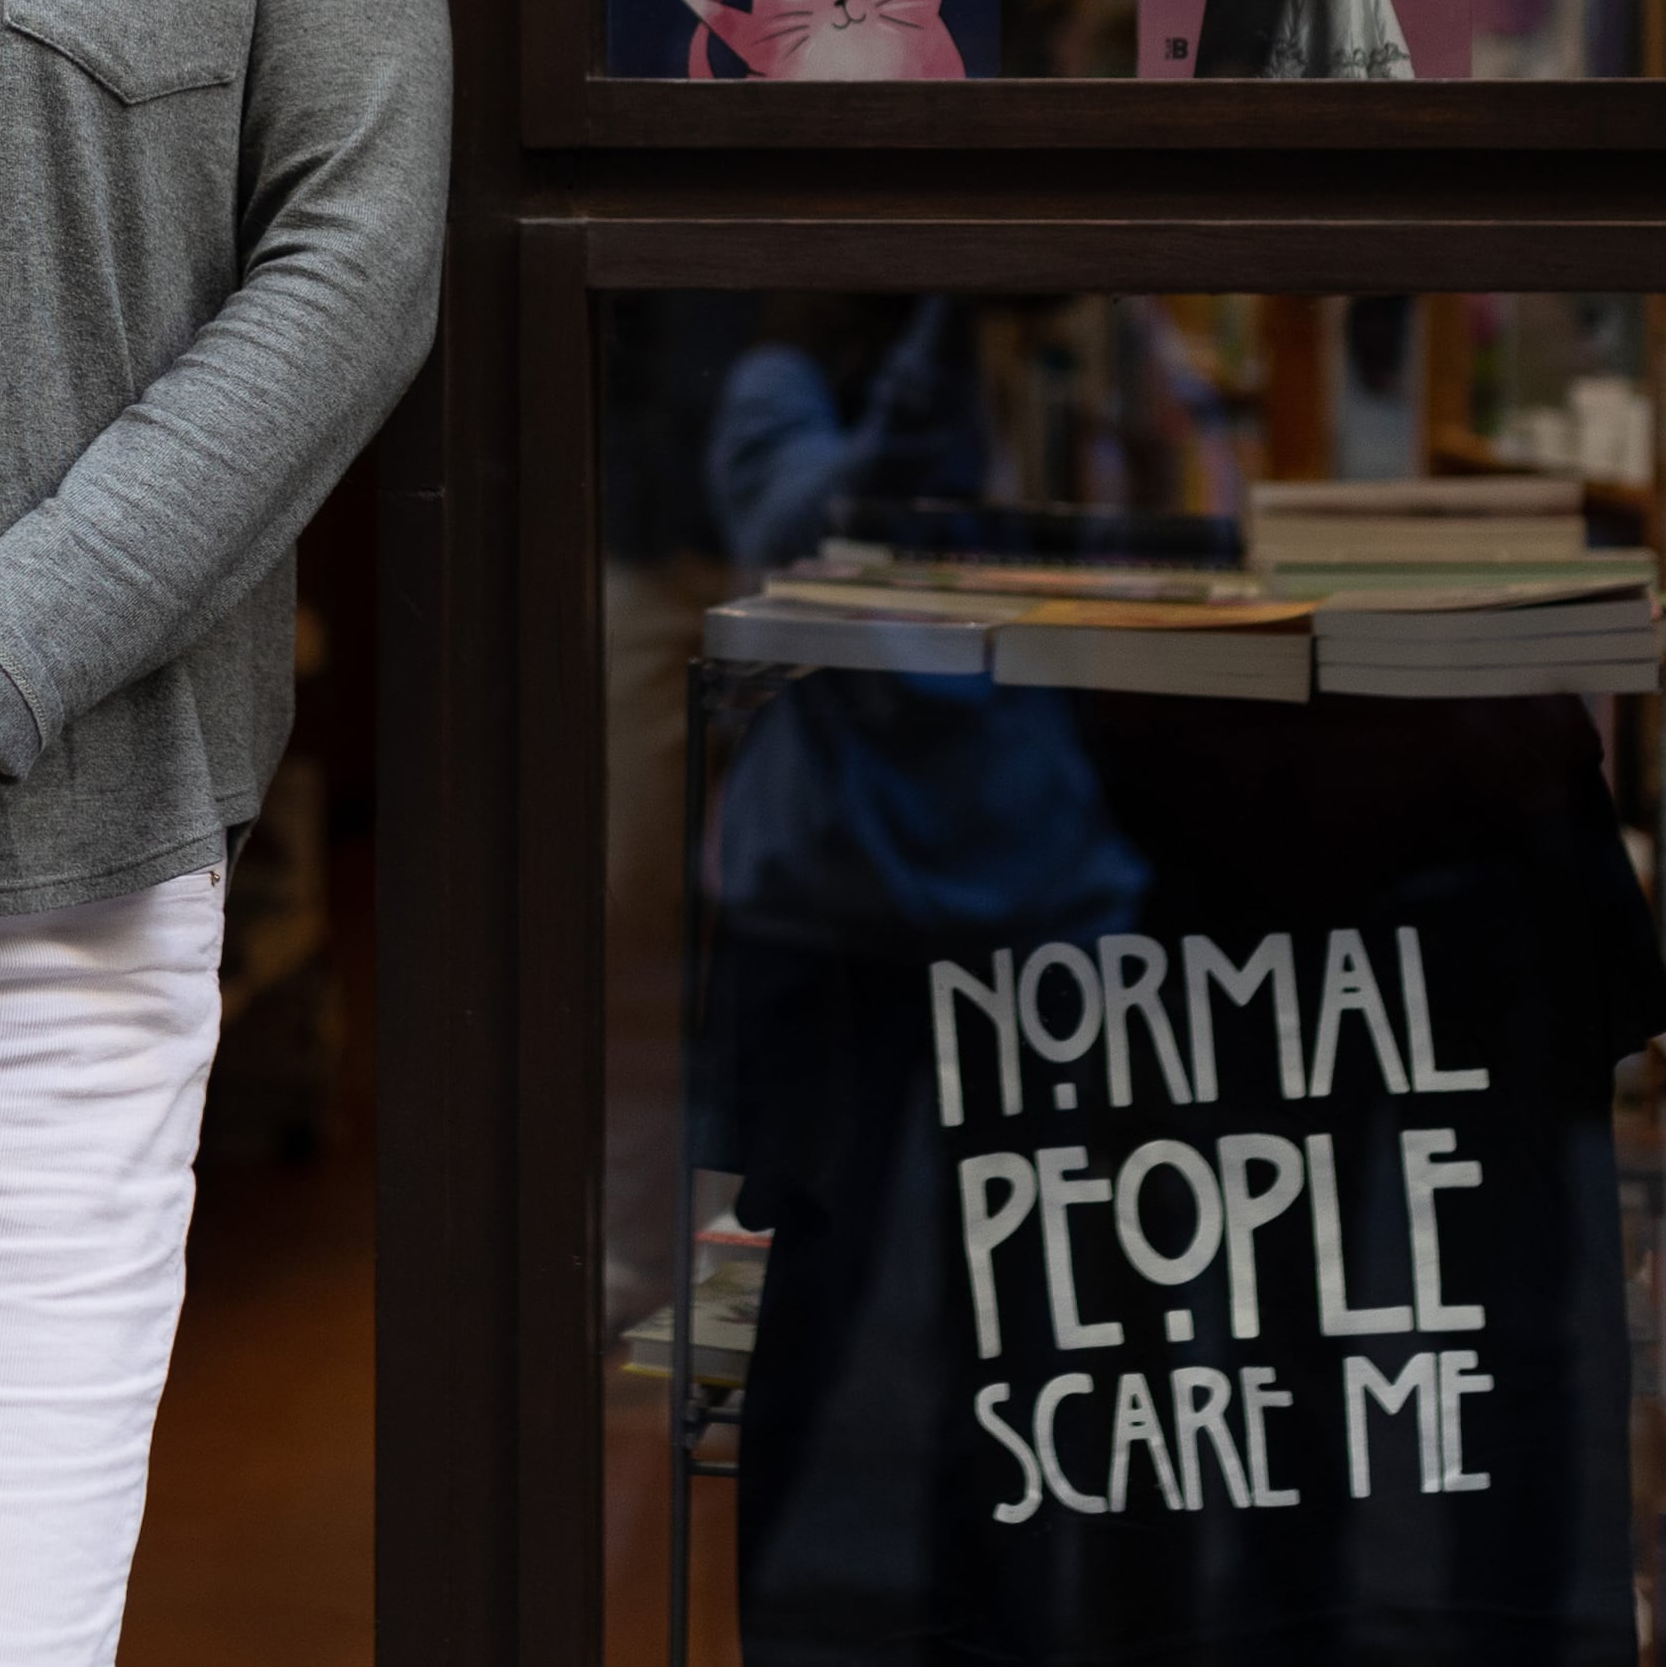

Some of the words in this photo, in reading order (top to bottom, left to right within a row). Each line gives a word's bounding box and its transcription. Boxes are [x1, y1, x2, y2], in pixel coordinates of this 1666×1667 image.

[929, 926, 1491, 1127] NORMAL
[957, 1127, 1486, 1360] PEOPLE
[973, 1364, 1302, 1526] SCARE
[1341, 1348, 1496, 1500] ME
